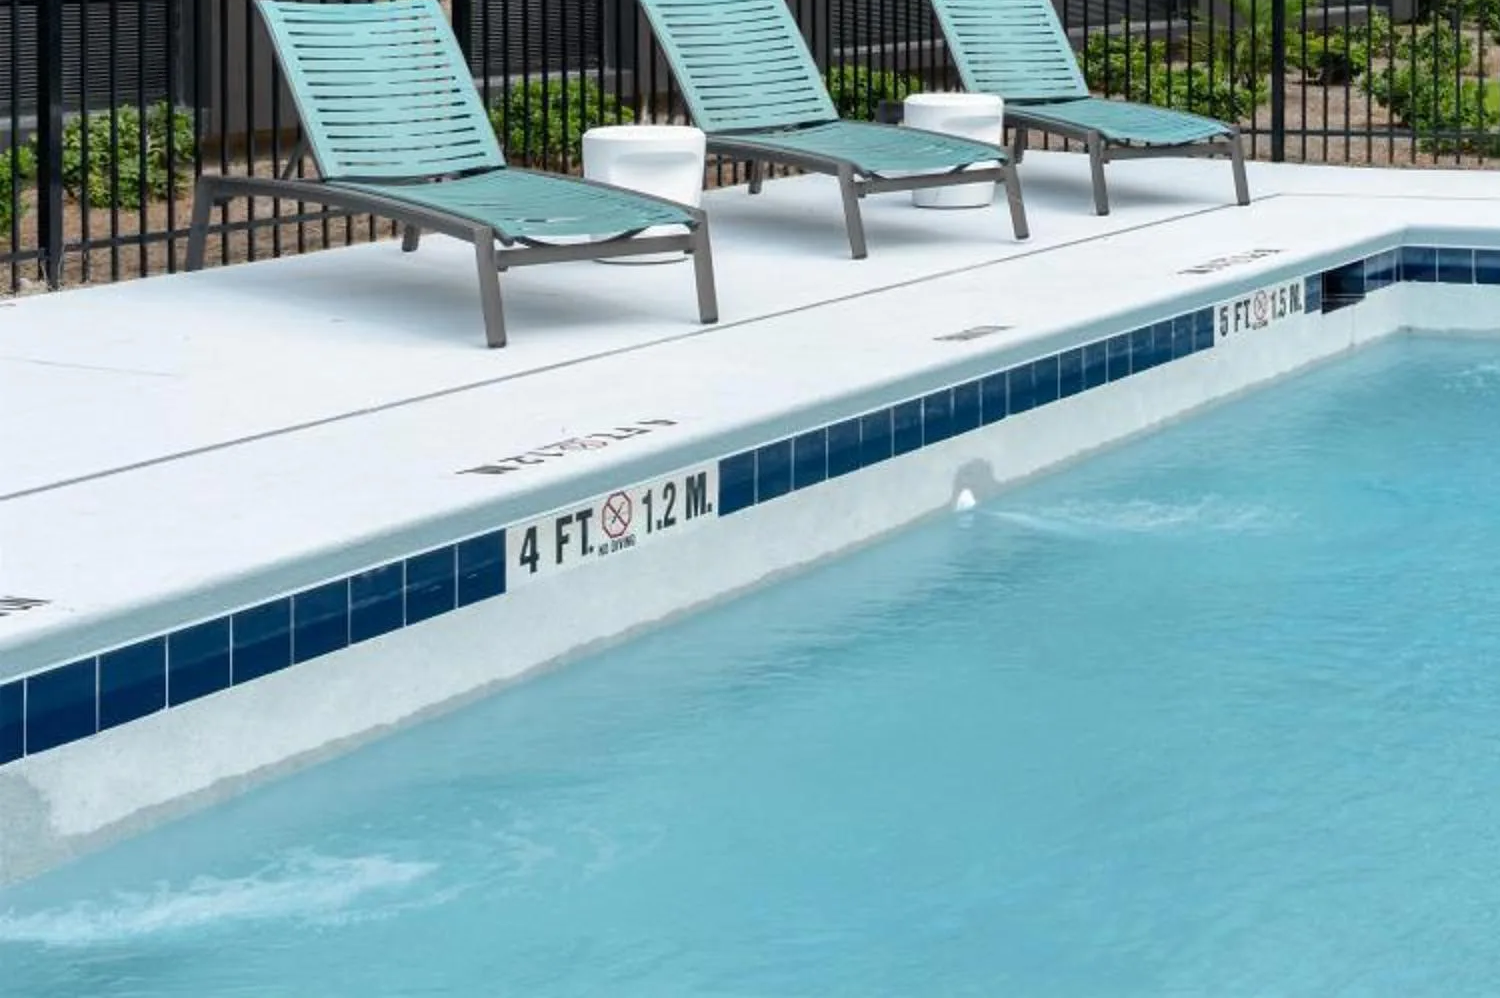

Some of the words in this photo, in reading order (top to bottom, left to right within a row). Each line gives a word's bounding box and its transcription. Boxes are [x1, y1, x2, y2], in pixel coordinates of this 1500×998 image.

[1220, 305, 1229, 337] 5
[519, 525, 540, 574] 4
[555, 508, 594, 565] FT.
[642, 481, 677, 534] 1.2
[685, 471, 713, 521] M.
